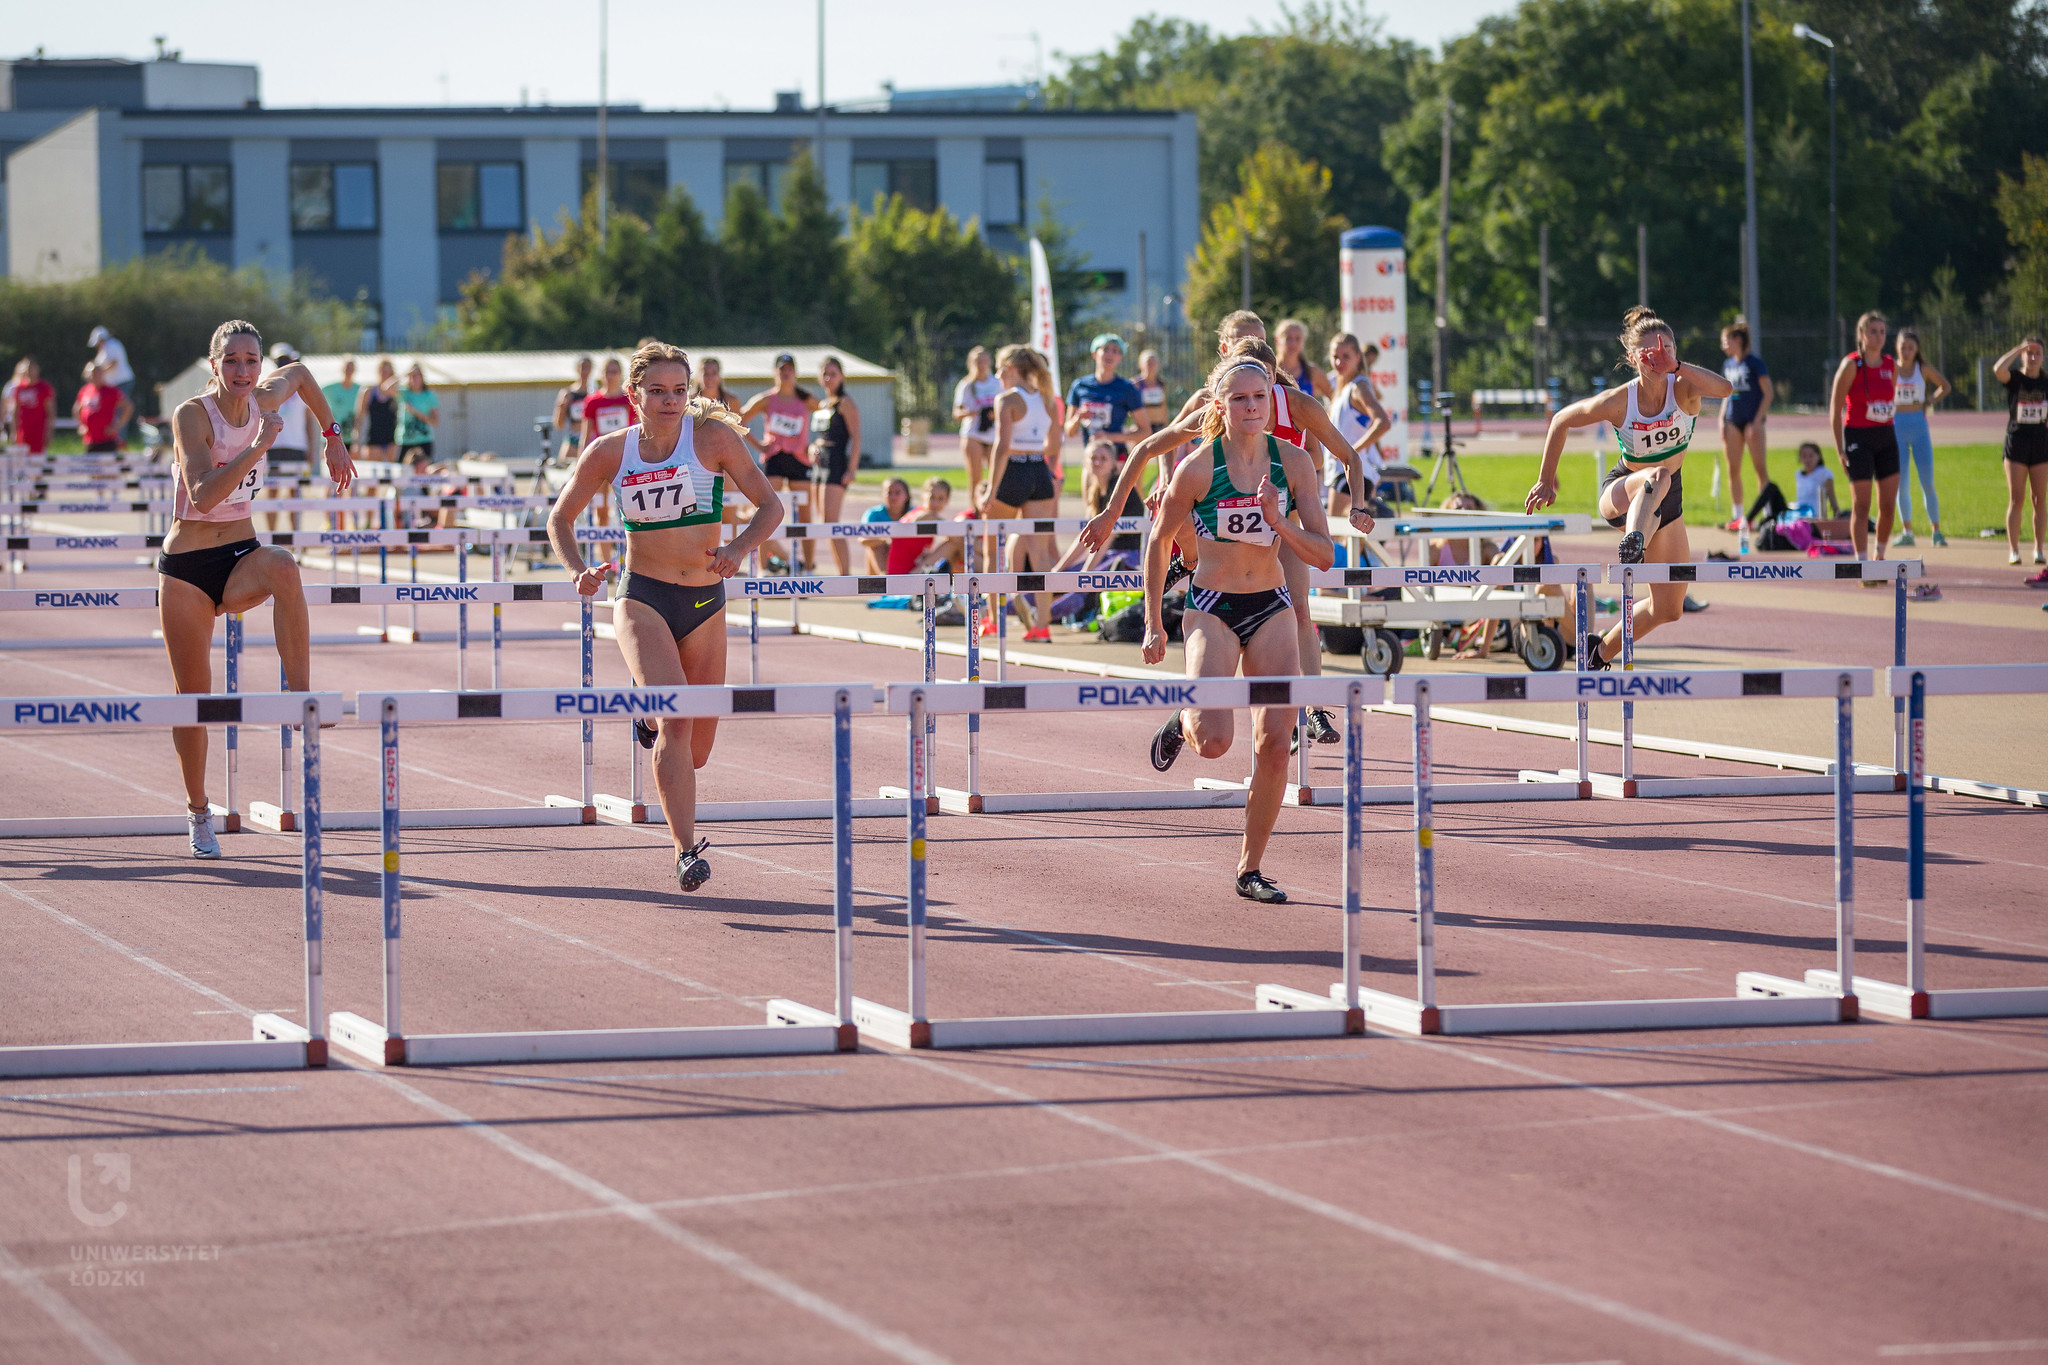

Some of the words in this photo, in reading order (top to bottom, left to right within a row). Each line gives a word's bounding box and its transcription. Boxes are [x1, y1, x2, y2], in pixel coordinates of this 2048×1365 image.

[1371, 373, 1397, 387] TOS
[1641, 427, 1680, 448] 199
[631, 483, 684, 511] 177
[831, 525, 891, 536] POLANIK
[1080, 521, 1137, 530] PNIK
[1227, 512, 1276, 534] 82
[56, 537, 119, 548] POLANIK
[320, 533, 381, 544] POLANIK
[576, 528, 626, 541] POLAN
[1404, 569, 1481, 584] POLANIK
[1727, 565, 1804, 580] POLANIK
[396, 586, 479, 601] POLANIK
[744, 580, 825, 596] POLANIK
[35, 592, 120, 608] POLANIK
[1079, 684, 1198, 706] POLANIK
[1577, 676, 1692, 698] POLANIK
[556, 693, 679, 714] POLANIK
[15, 702, 143, 724] POLANIK
[386, 748, 396, 804] POLANIK
